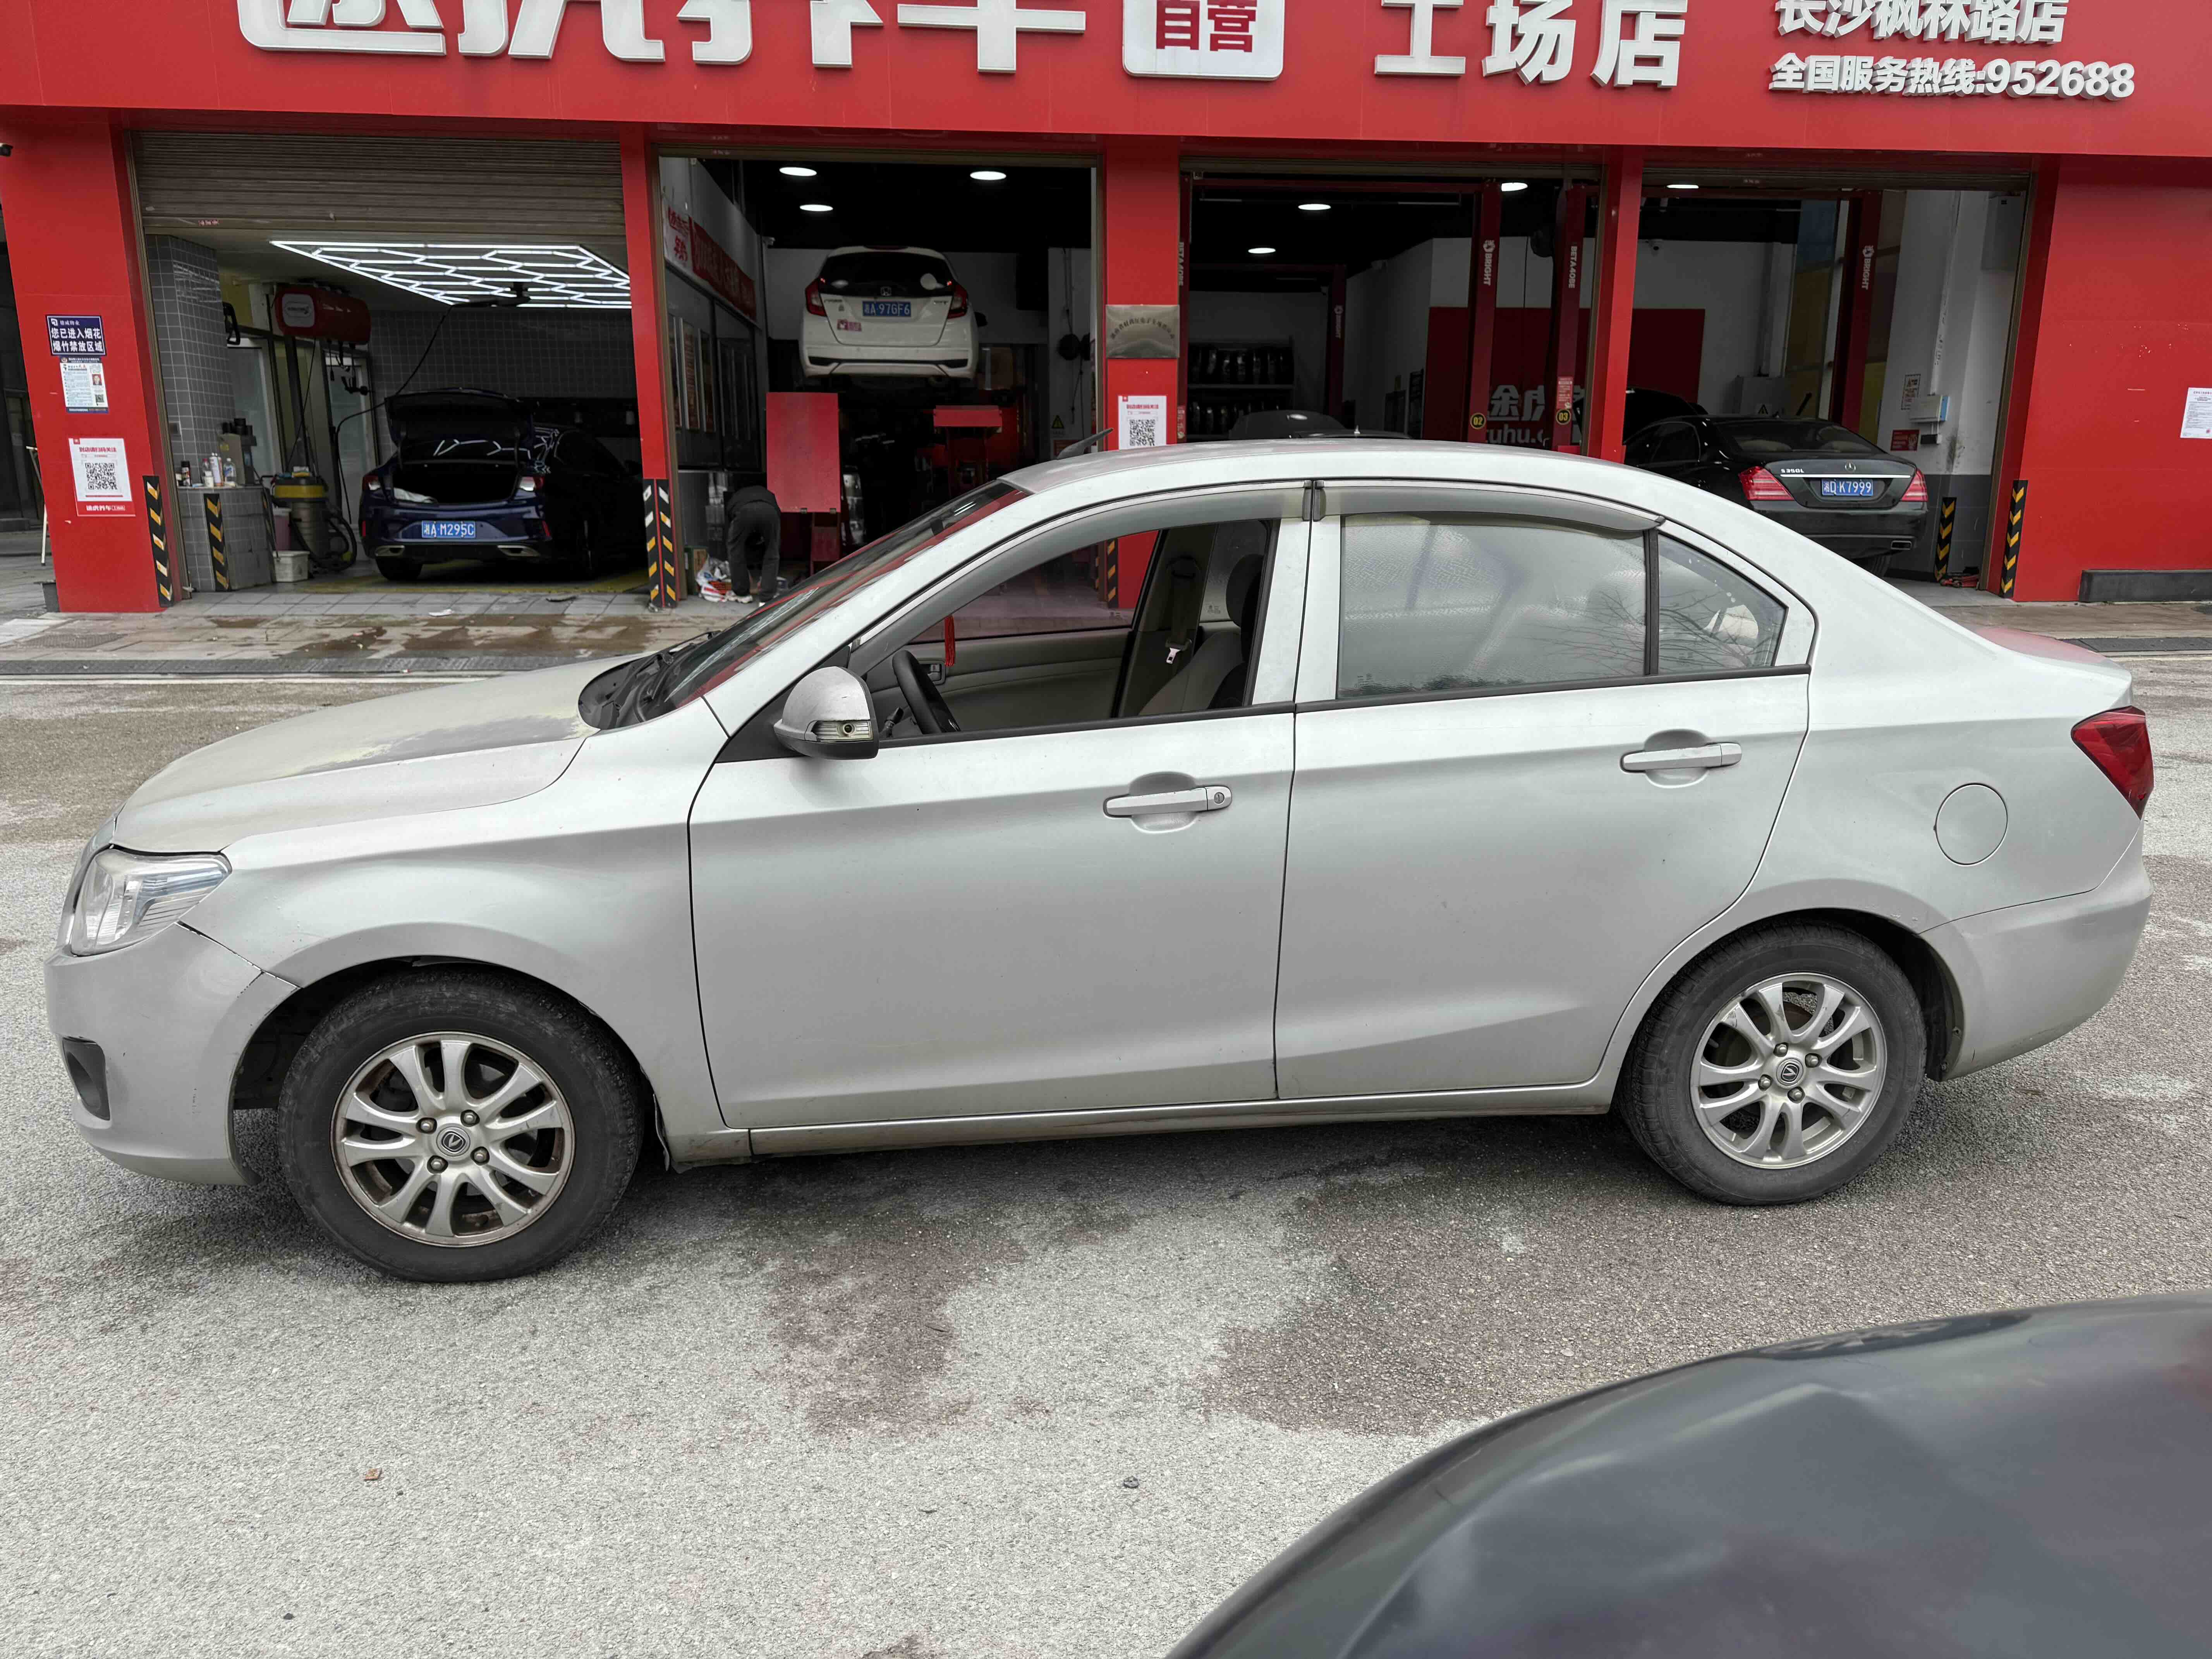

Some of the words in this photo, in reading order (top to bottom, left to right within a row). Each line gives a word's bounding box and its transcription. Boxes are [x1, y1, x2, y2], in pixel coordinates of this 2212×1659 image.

[1483, 253, 1492, 286] BRIGHT
[1862, 258, 1872, 291] BRIGHT
[51, 328, 101, 339] 您已进入烟花
[53, 340, 103, 352] 爆竹禁放区域
[1473, 417, 1483, 425] 02
[1559, 412, 1568, 421] 03
